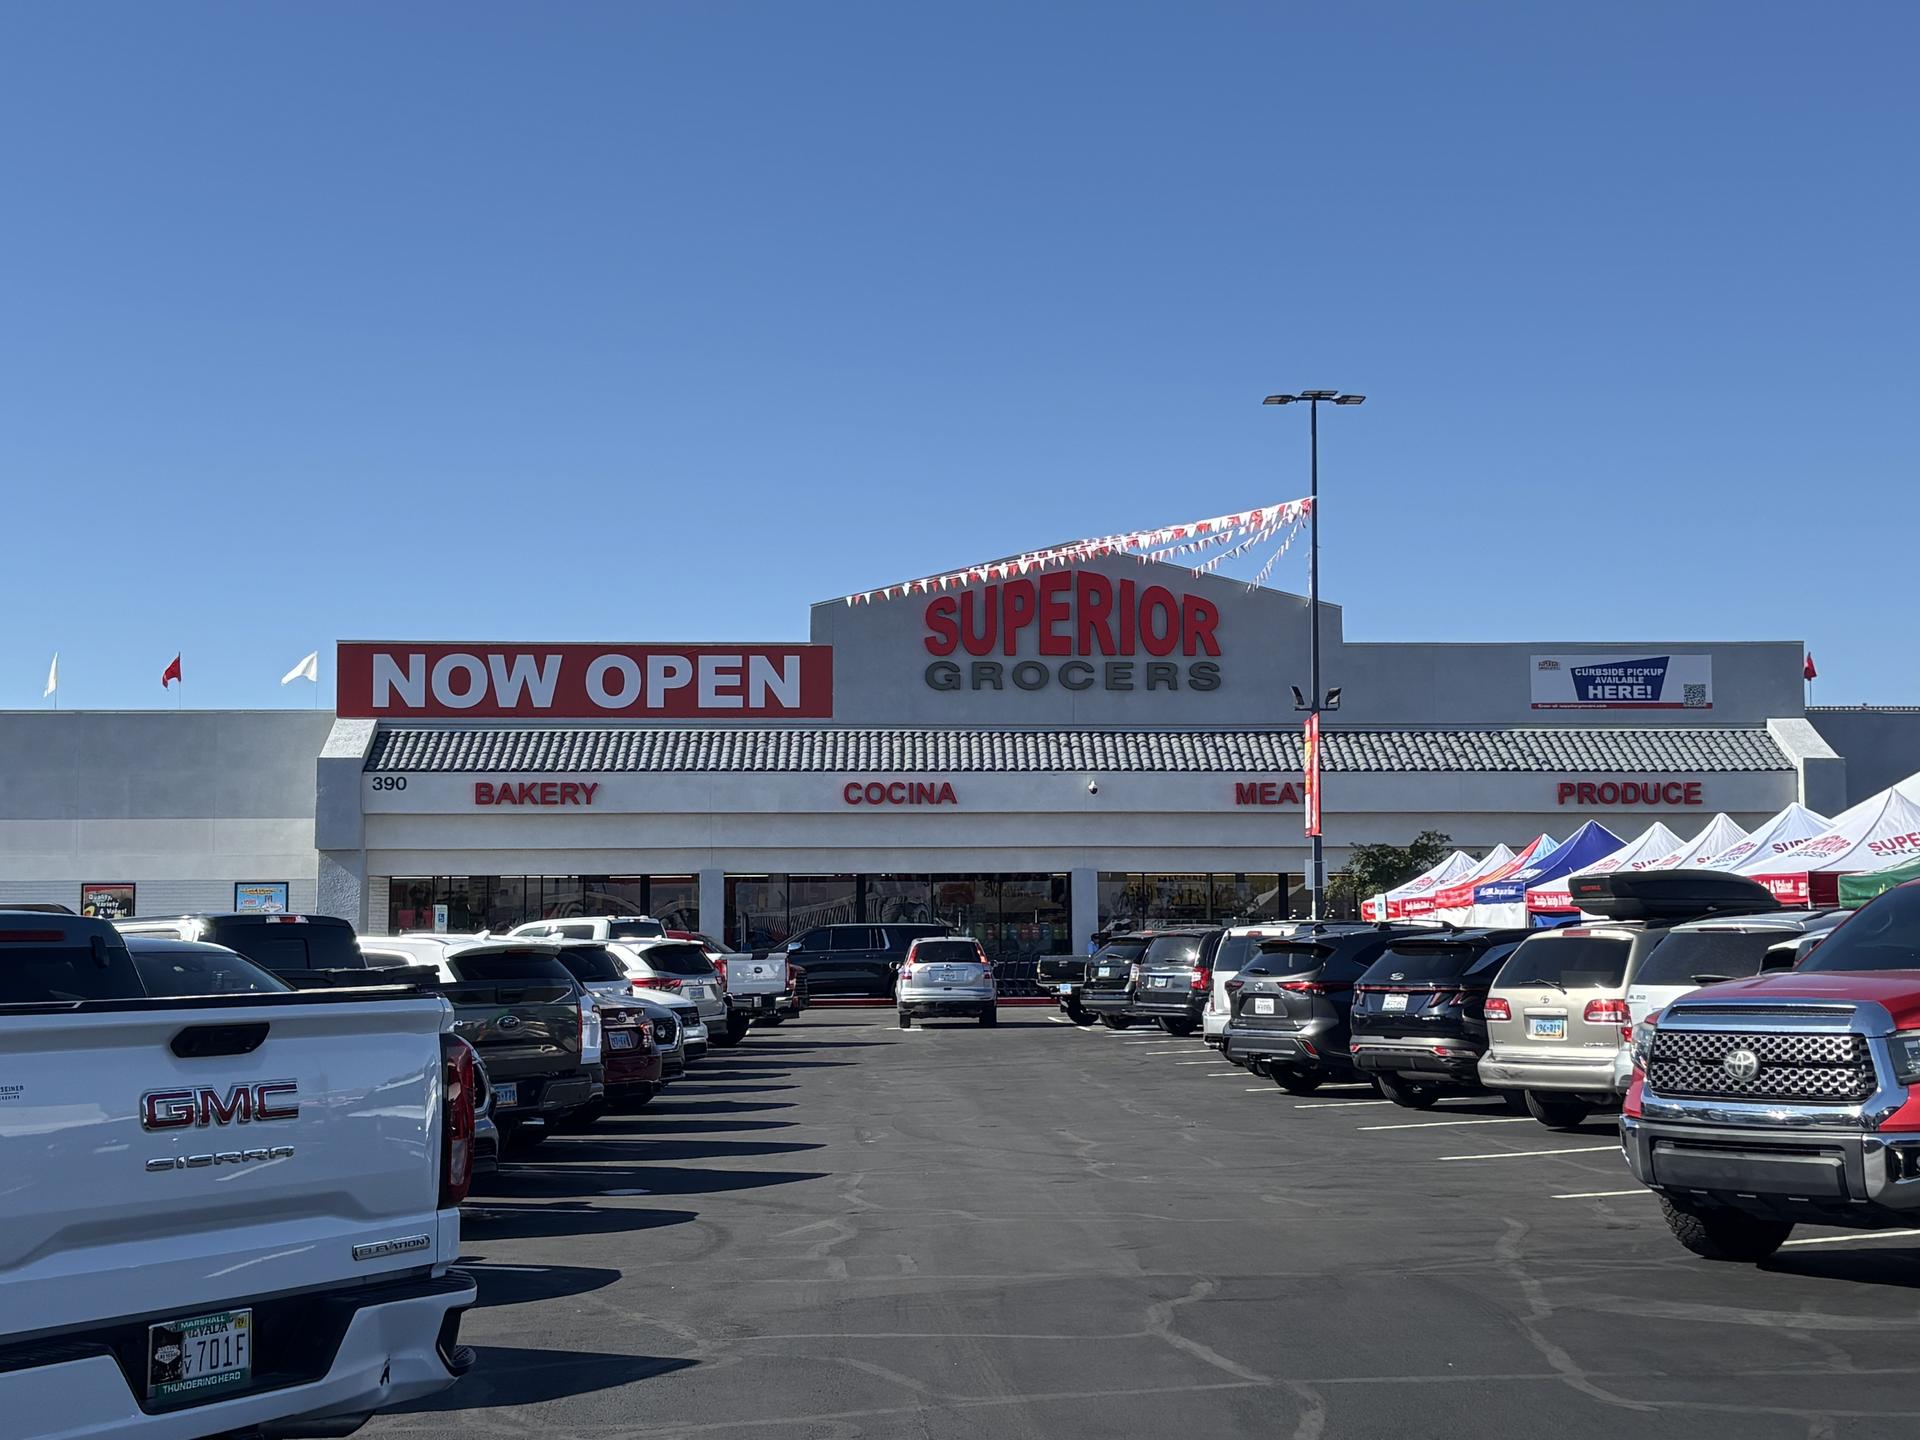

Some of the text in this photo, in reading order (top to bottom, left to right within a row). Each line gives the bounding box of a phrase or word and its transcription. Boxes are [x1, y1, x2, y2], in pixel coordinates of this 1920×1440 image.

[924, 570, 1222, 657] SUPERIOR
[372, 653, 801, 708] NOW OPEN
[925, 660, 1222, 691] GROCERS
[1575, 668, 1664, 676] CURBSIDE PICKUP
[1588, 685, 1652, 699] HERE!
[372, 776, 407, 792] 390
[474, 782, 598, 806] BAKERY
[844, 782, 957, 805] COCINA
[1558, 782, 1703, 805] PRODUCE
[1867, 831, 1920, 852] SUPE
[141, 1079, 299, 1132] GMC
[146, 1146, 295, 1172] SIERRA
[360, 1238, 425, 1256] ELEVATION
[181, 1315, 225, 1328] MARSHALL
[197, 1333, 246, 1373] 701F
[163, 1372, 241, 1394] THUNDERING HERD
